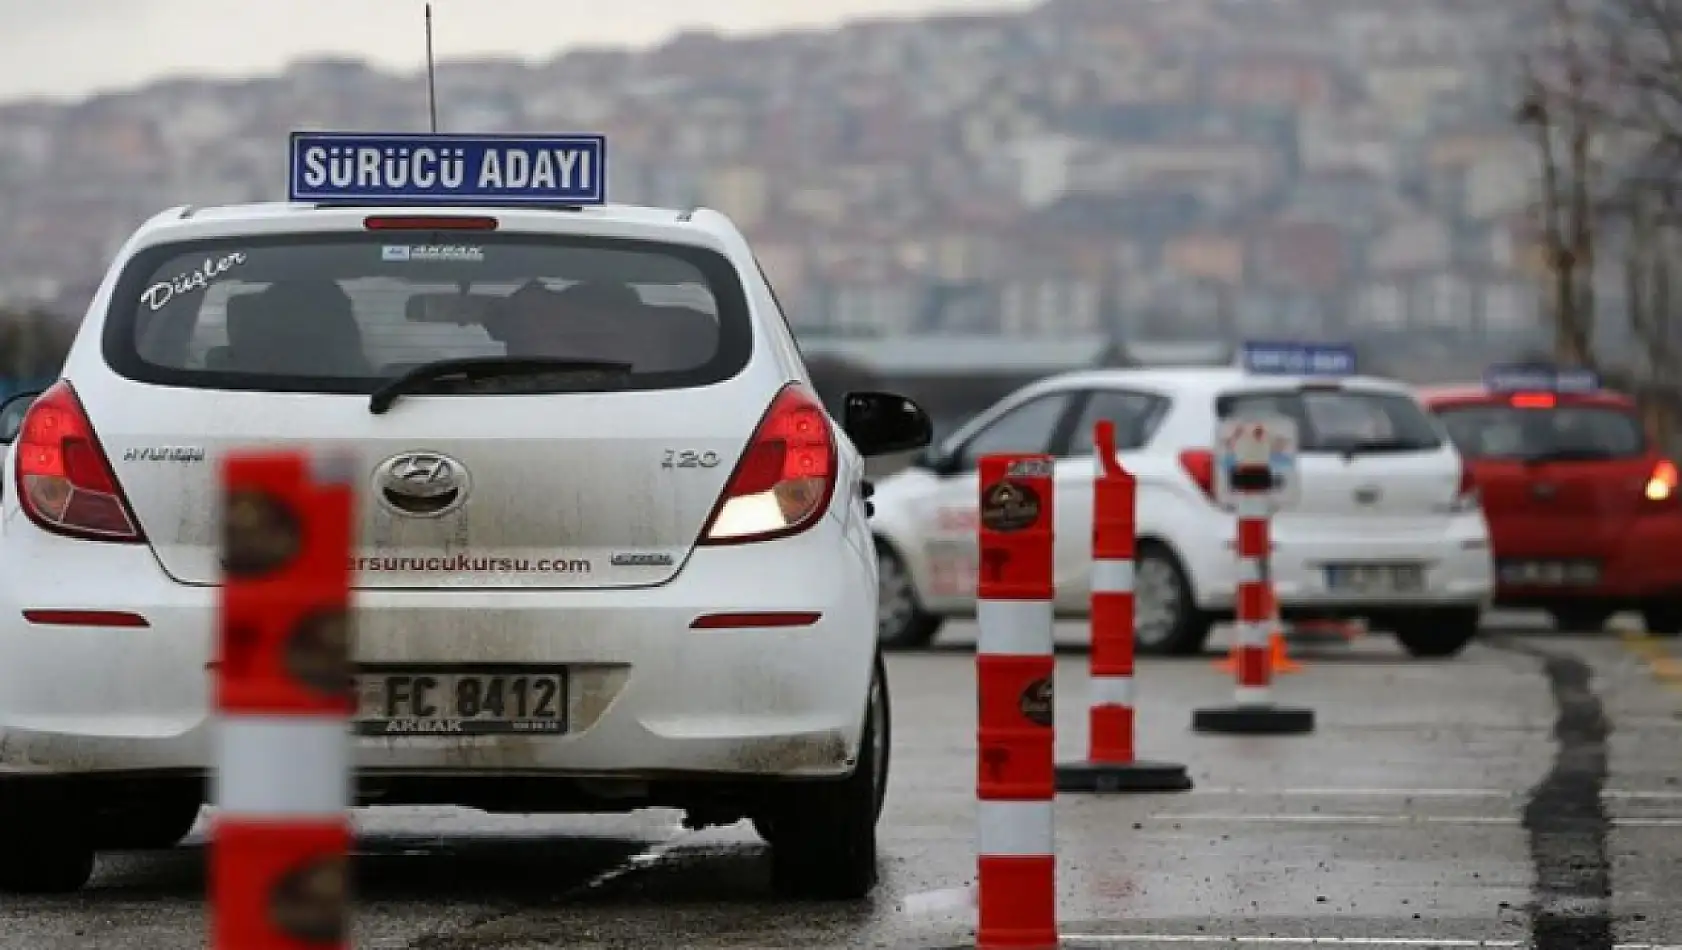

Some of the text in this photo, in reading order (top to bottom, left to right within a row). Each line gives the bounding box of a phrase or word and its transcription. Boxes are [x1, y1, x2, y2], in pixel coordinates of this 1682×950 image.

[303, 146, 591, 189] SÜRÜCÜ ADAYI
[345, 553, 592, 573] ersurucukursu.com
[384, 675, 557, 718] FC 8412
